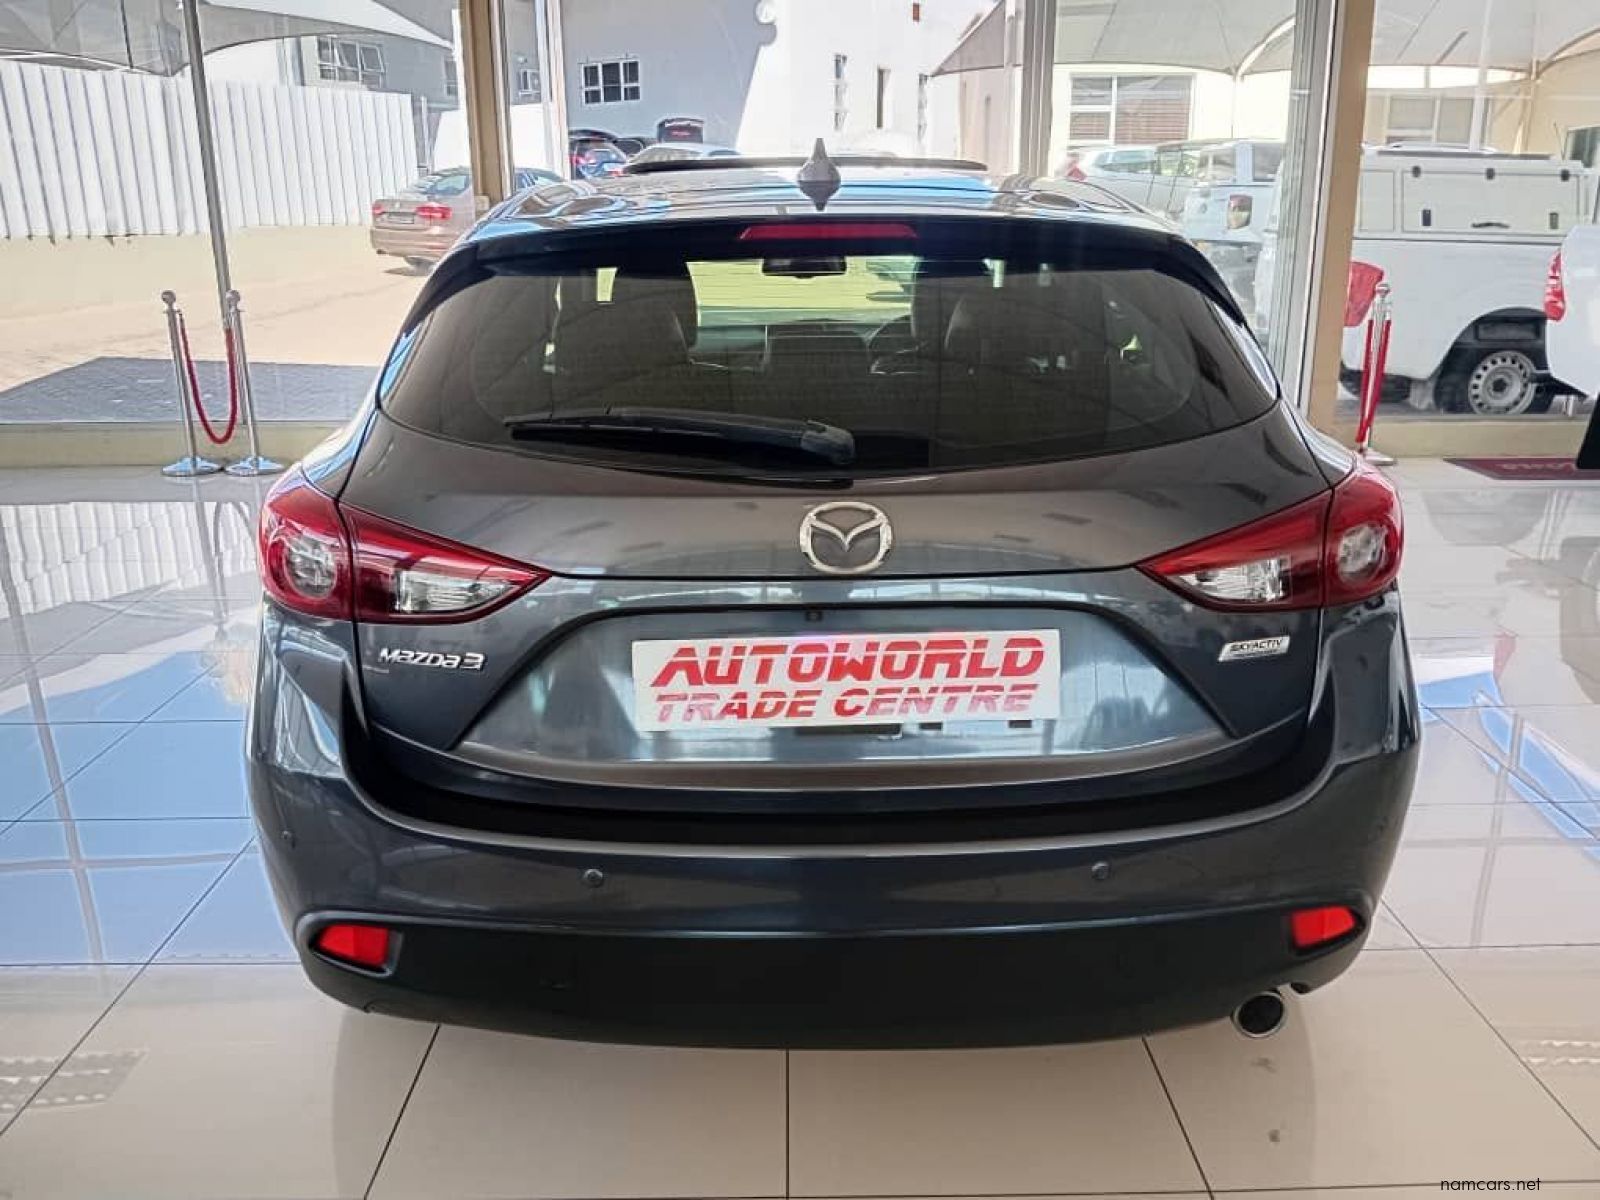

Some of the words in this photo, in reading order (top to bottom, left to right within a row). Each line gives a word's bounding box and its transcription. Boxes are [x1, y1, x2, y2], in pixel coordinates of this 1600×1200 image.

[650, 637, 1045, 687] AUTOWORLD
[656, 689, 821, 722] TRADE
[833, 683, 1039, 717] CENTRE
